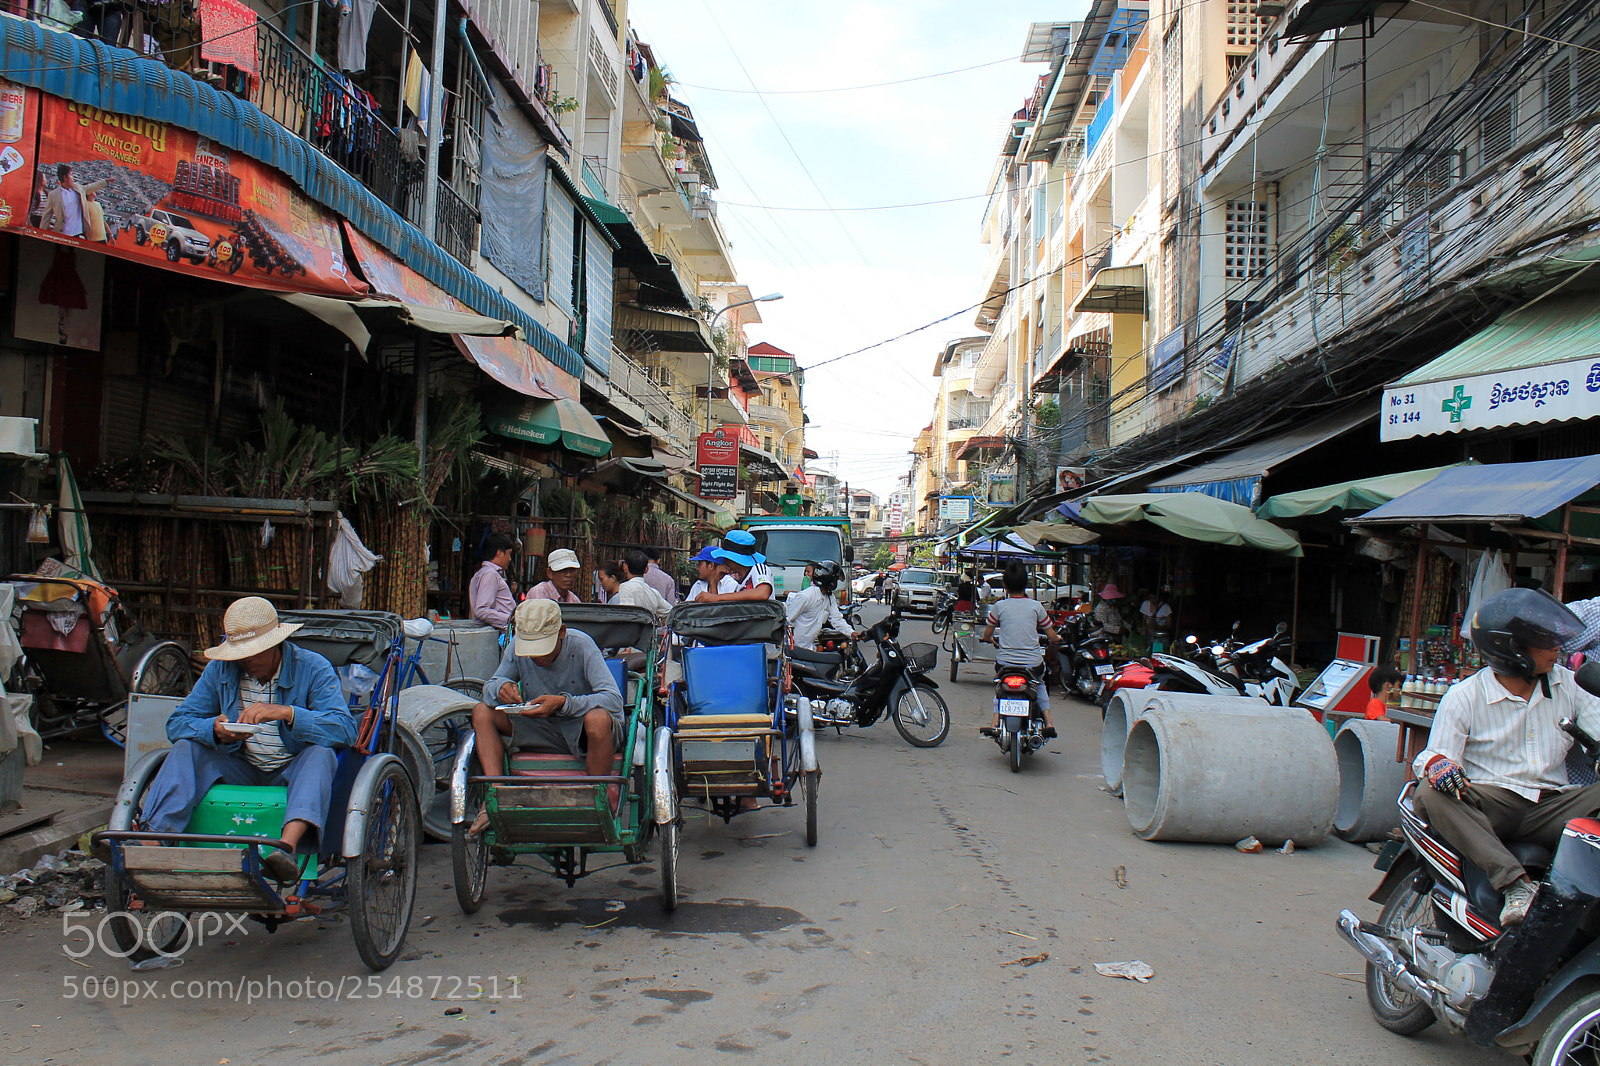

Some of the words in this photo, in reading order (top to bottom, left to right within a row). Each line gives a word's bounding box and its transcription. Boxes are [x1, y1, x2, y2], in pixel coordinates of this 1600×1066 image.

[93, 131, 117, 148] WIN
[118, 140, 142, 154] 100
[152, 227, 166, 236] 100
[219, 245, 232, 253] 100
[1390, 395, 1402, 407] No
[1404, 393, 1415, 404] 31
[1389, 414, 1399, 424] St
[1402, 411, 1421, 423] 144
[507, 425, 545, 440] Heineken
[705, 439, 734, 448] Angkor
